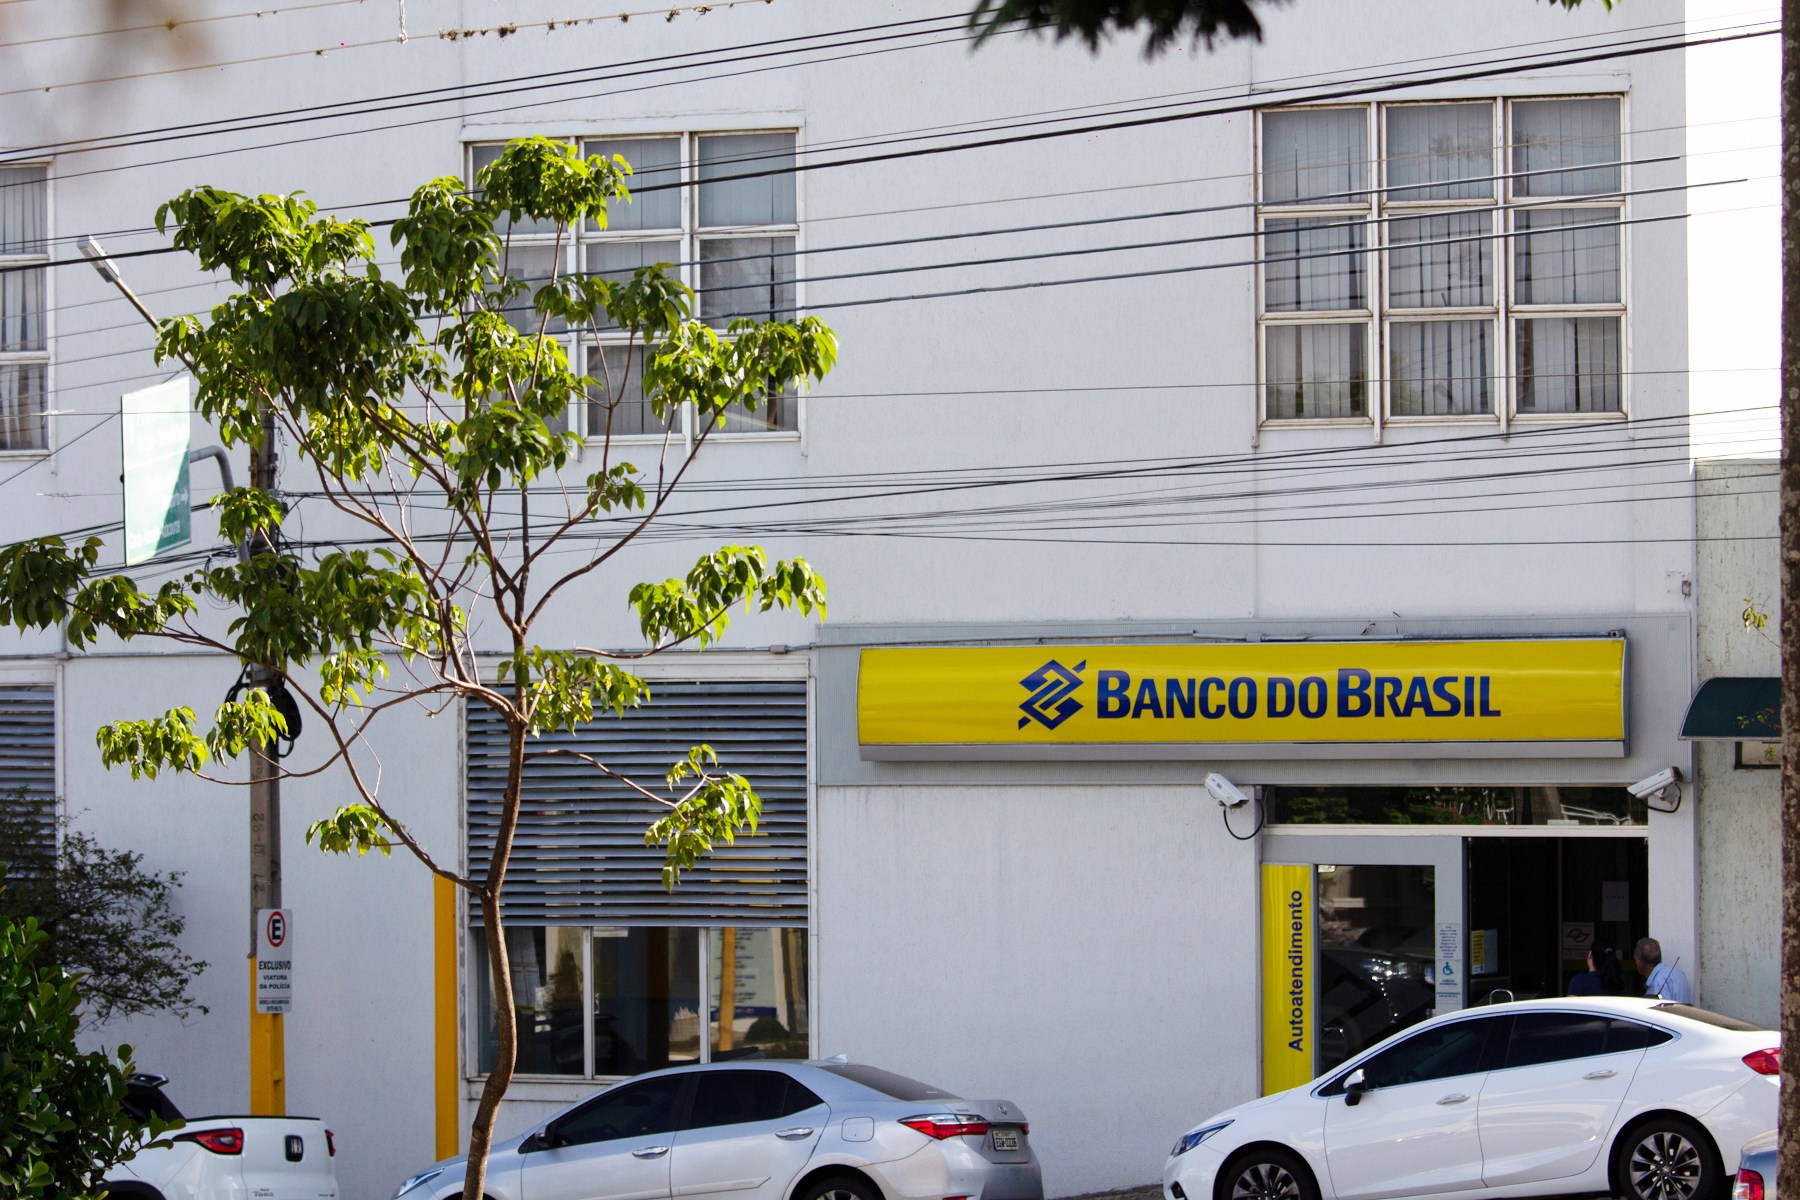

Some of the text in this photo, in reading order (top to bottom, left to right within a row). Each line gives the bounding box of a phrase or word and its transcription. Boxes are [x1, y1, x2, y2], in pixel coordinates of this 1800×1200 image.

[1097, 668, 1501, 719] BANCO DO BRASIL
[272, 919, 281, 940] E
[259, 960, 291, 970] EXCLUSIVO
[1288, 890, 1303, 1052] Autoatendimento
